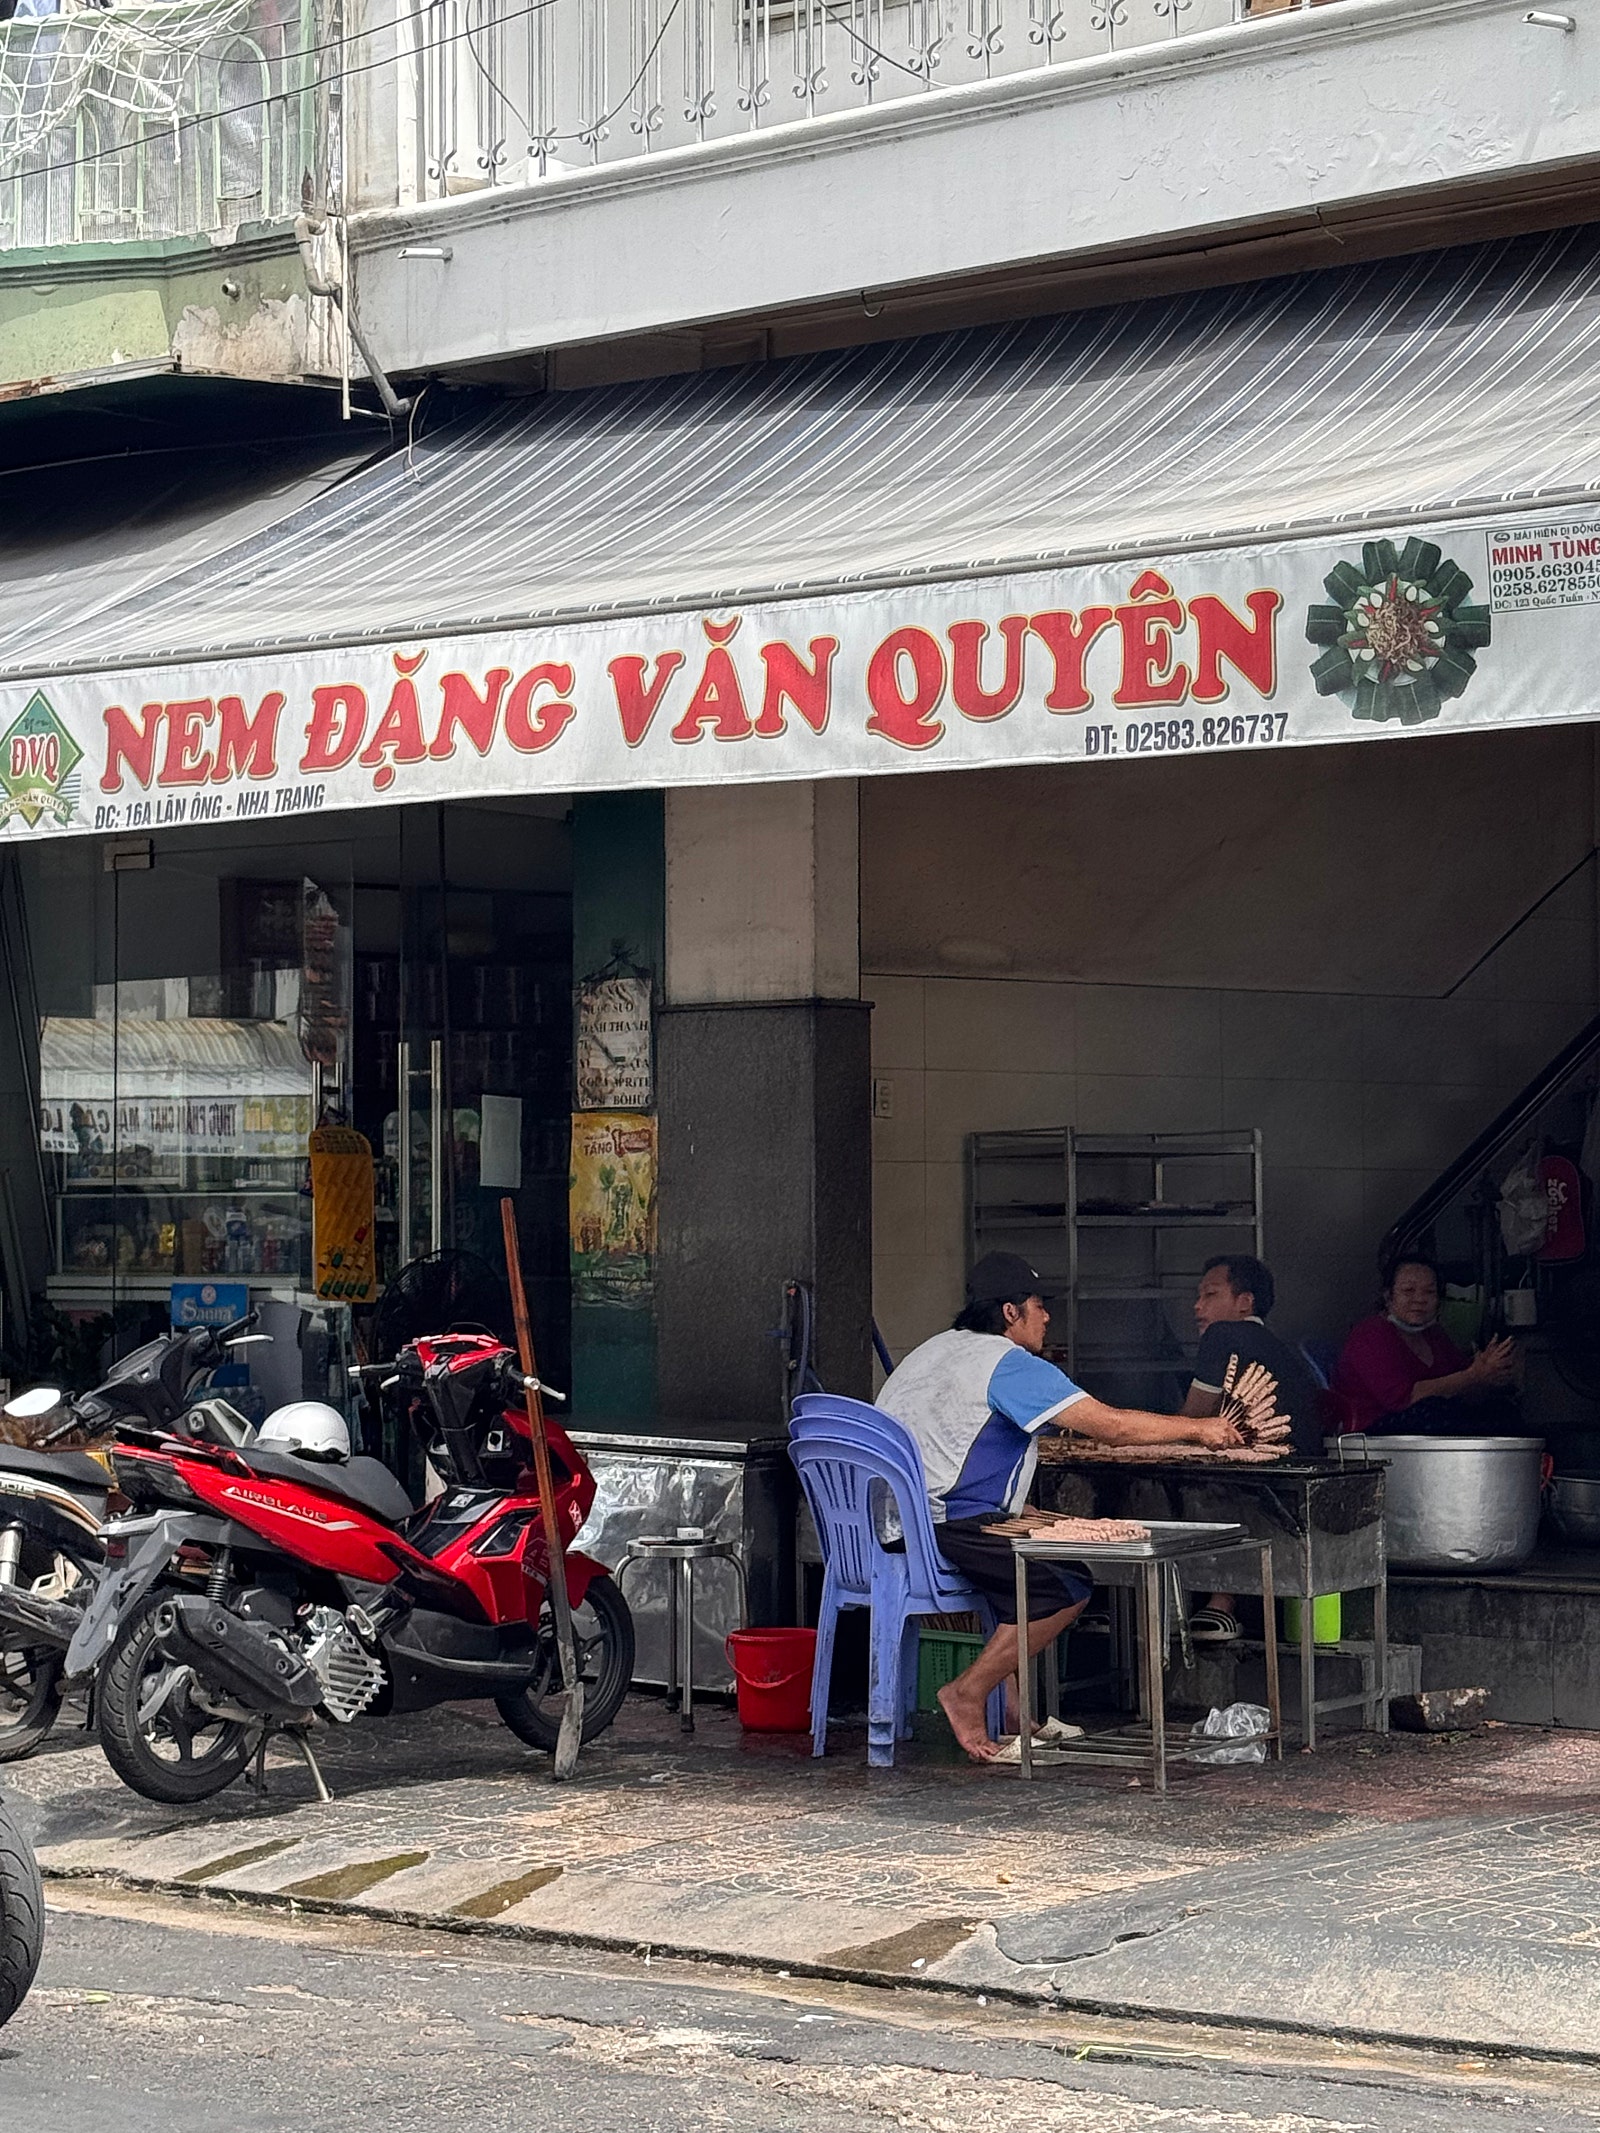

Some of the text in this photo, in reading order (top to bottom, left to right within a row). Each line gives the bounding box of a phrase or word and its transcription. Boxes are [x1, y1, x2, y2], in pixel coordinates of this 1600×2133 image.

[1492, 536, 1600, 566] MINH TÙNG
[100, 569, 1285, 794] NEM ĐẶNG VĂN QUYÊN
[1085, 712, 1289, 756] ĐT: 02583.826737
[94, 804, 120, 830] ĐC:
[125, 803, 151, 828] 16A
[156, 794, 187, 824] LÃN
[190, 792, 223, 821] ÔNG
[236, 791, 269, 817] NHA
[274, 784, 326, 813] TRANG
